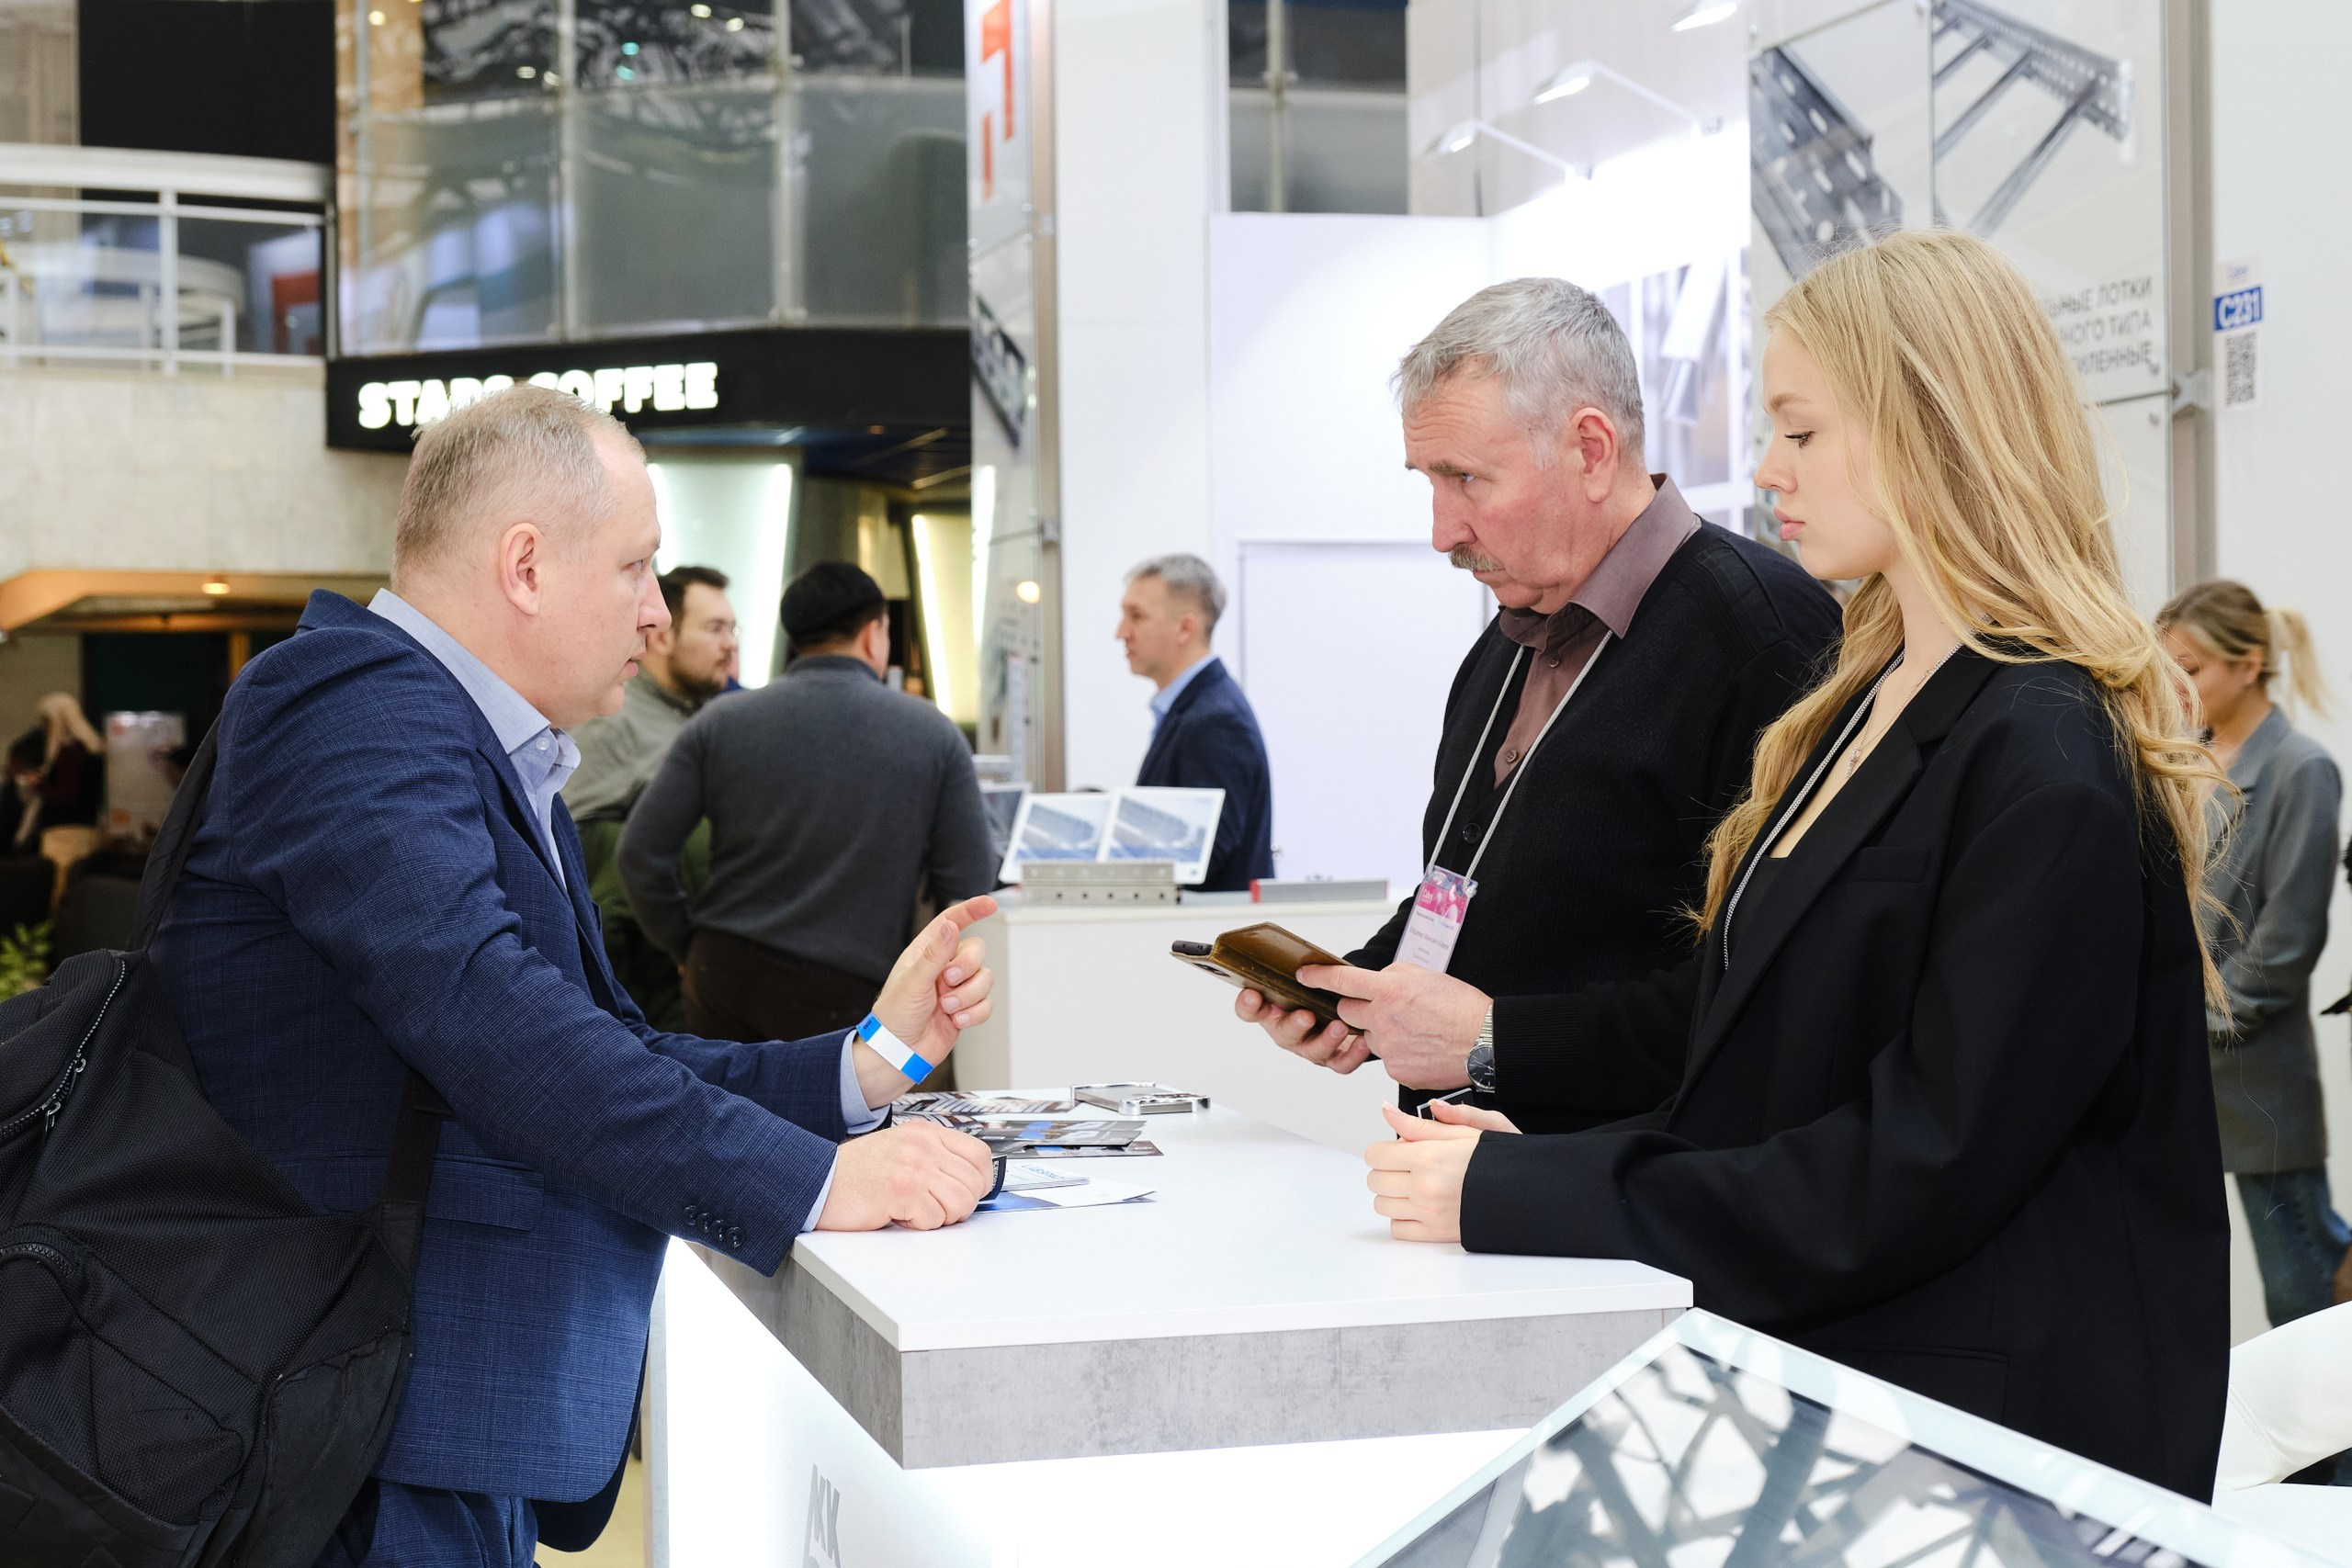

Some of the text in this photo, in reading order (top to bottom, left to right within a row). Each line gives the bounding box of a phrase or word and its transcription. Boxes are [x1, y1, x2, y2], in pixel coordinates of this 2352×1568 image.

[2096, 275, 2153, 309] ЛОТКИ
[2109, 309, 2153, 337] ТИПА
[2073, 340, 2153, 378] ИЛЕННЫЕ
